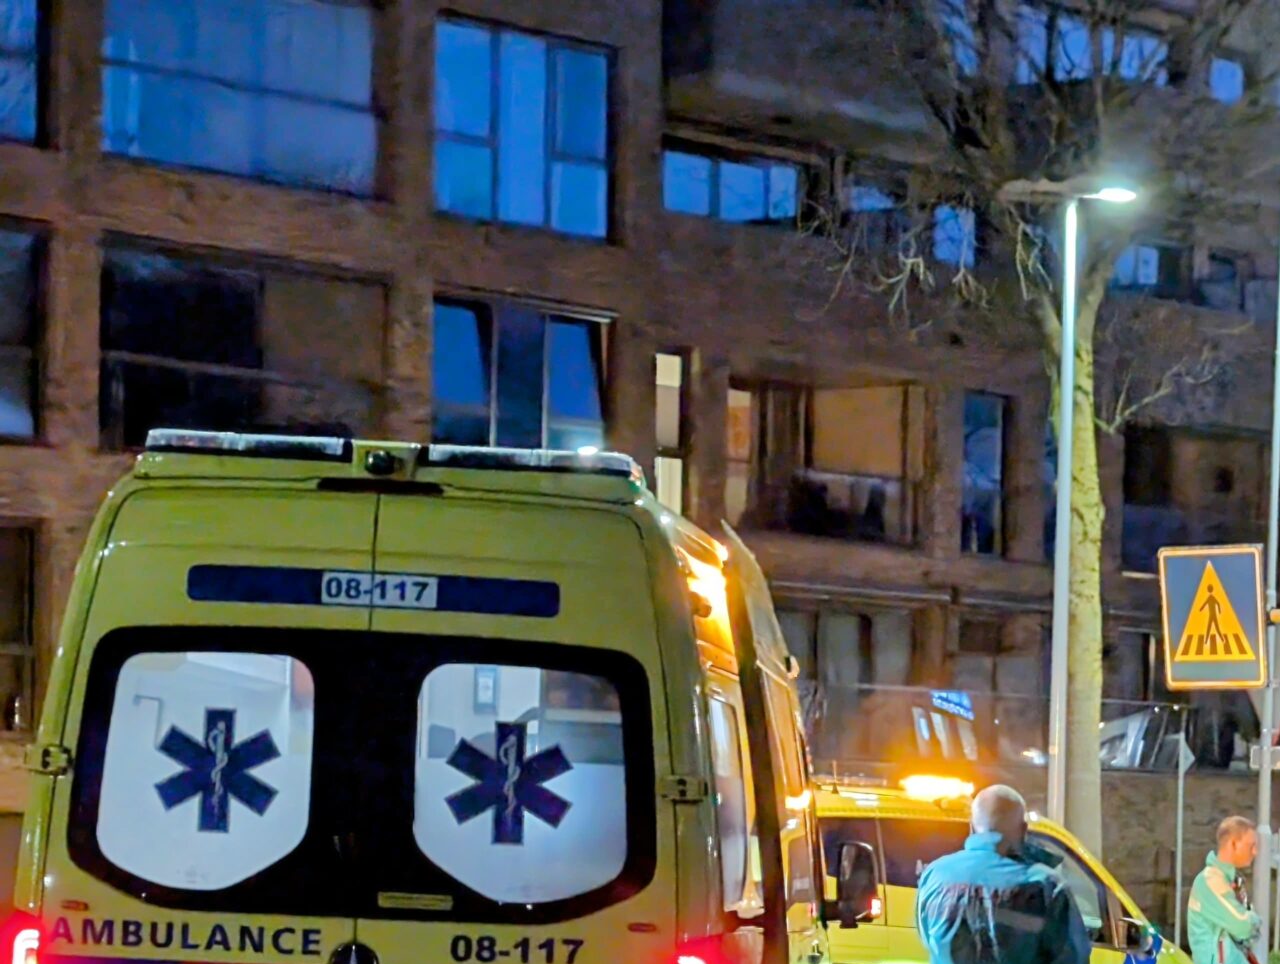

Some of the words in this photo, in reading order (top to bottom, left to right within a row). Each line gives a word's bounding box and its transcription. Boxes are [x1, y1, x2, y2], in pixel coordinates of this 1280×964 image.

[325, 576, 430, 602] 08-117
[50, 916, 322, 956] AMBULANCE
[450, 934, 584, 964] 08-117
